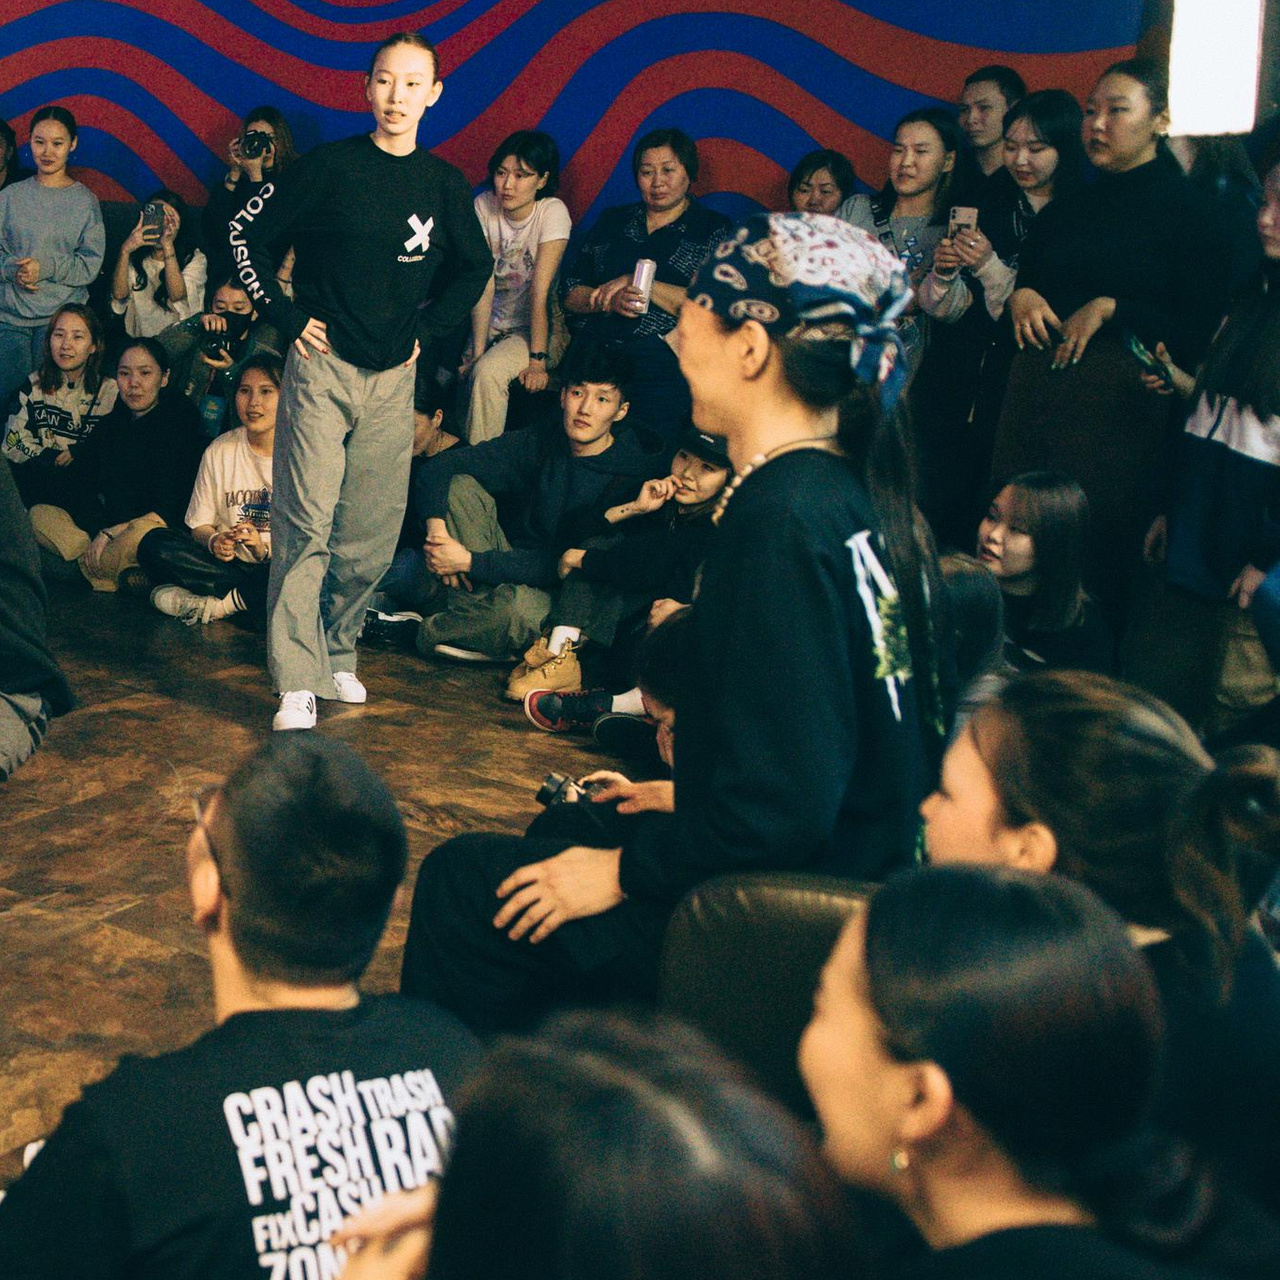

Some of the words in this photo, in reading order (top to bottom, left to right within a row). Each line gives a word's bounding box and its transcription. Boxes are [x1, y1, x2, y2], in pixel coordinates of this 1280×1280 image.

[223, 1070, 366, 1150] CRASH
[357, 1068, 445, 1120] TRASH
[237, 1123, 377, 1206] FRESH
[252, 1210, 299, 1253] FIX
